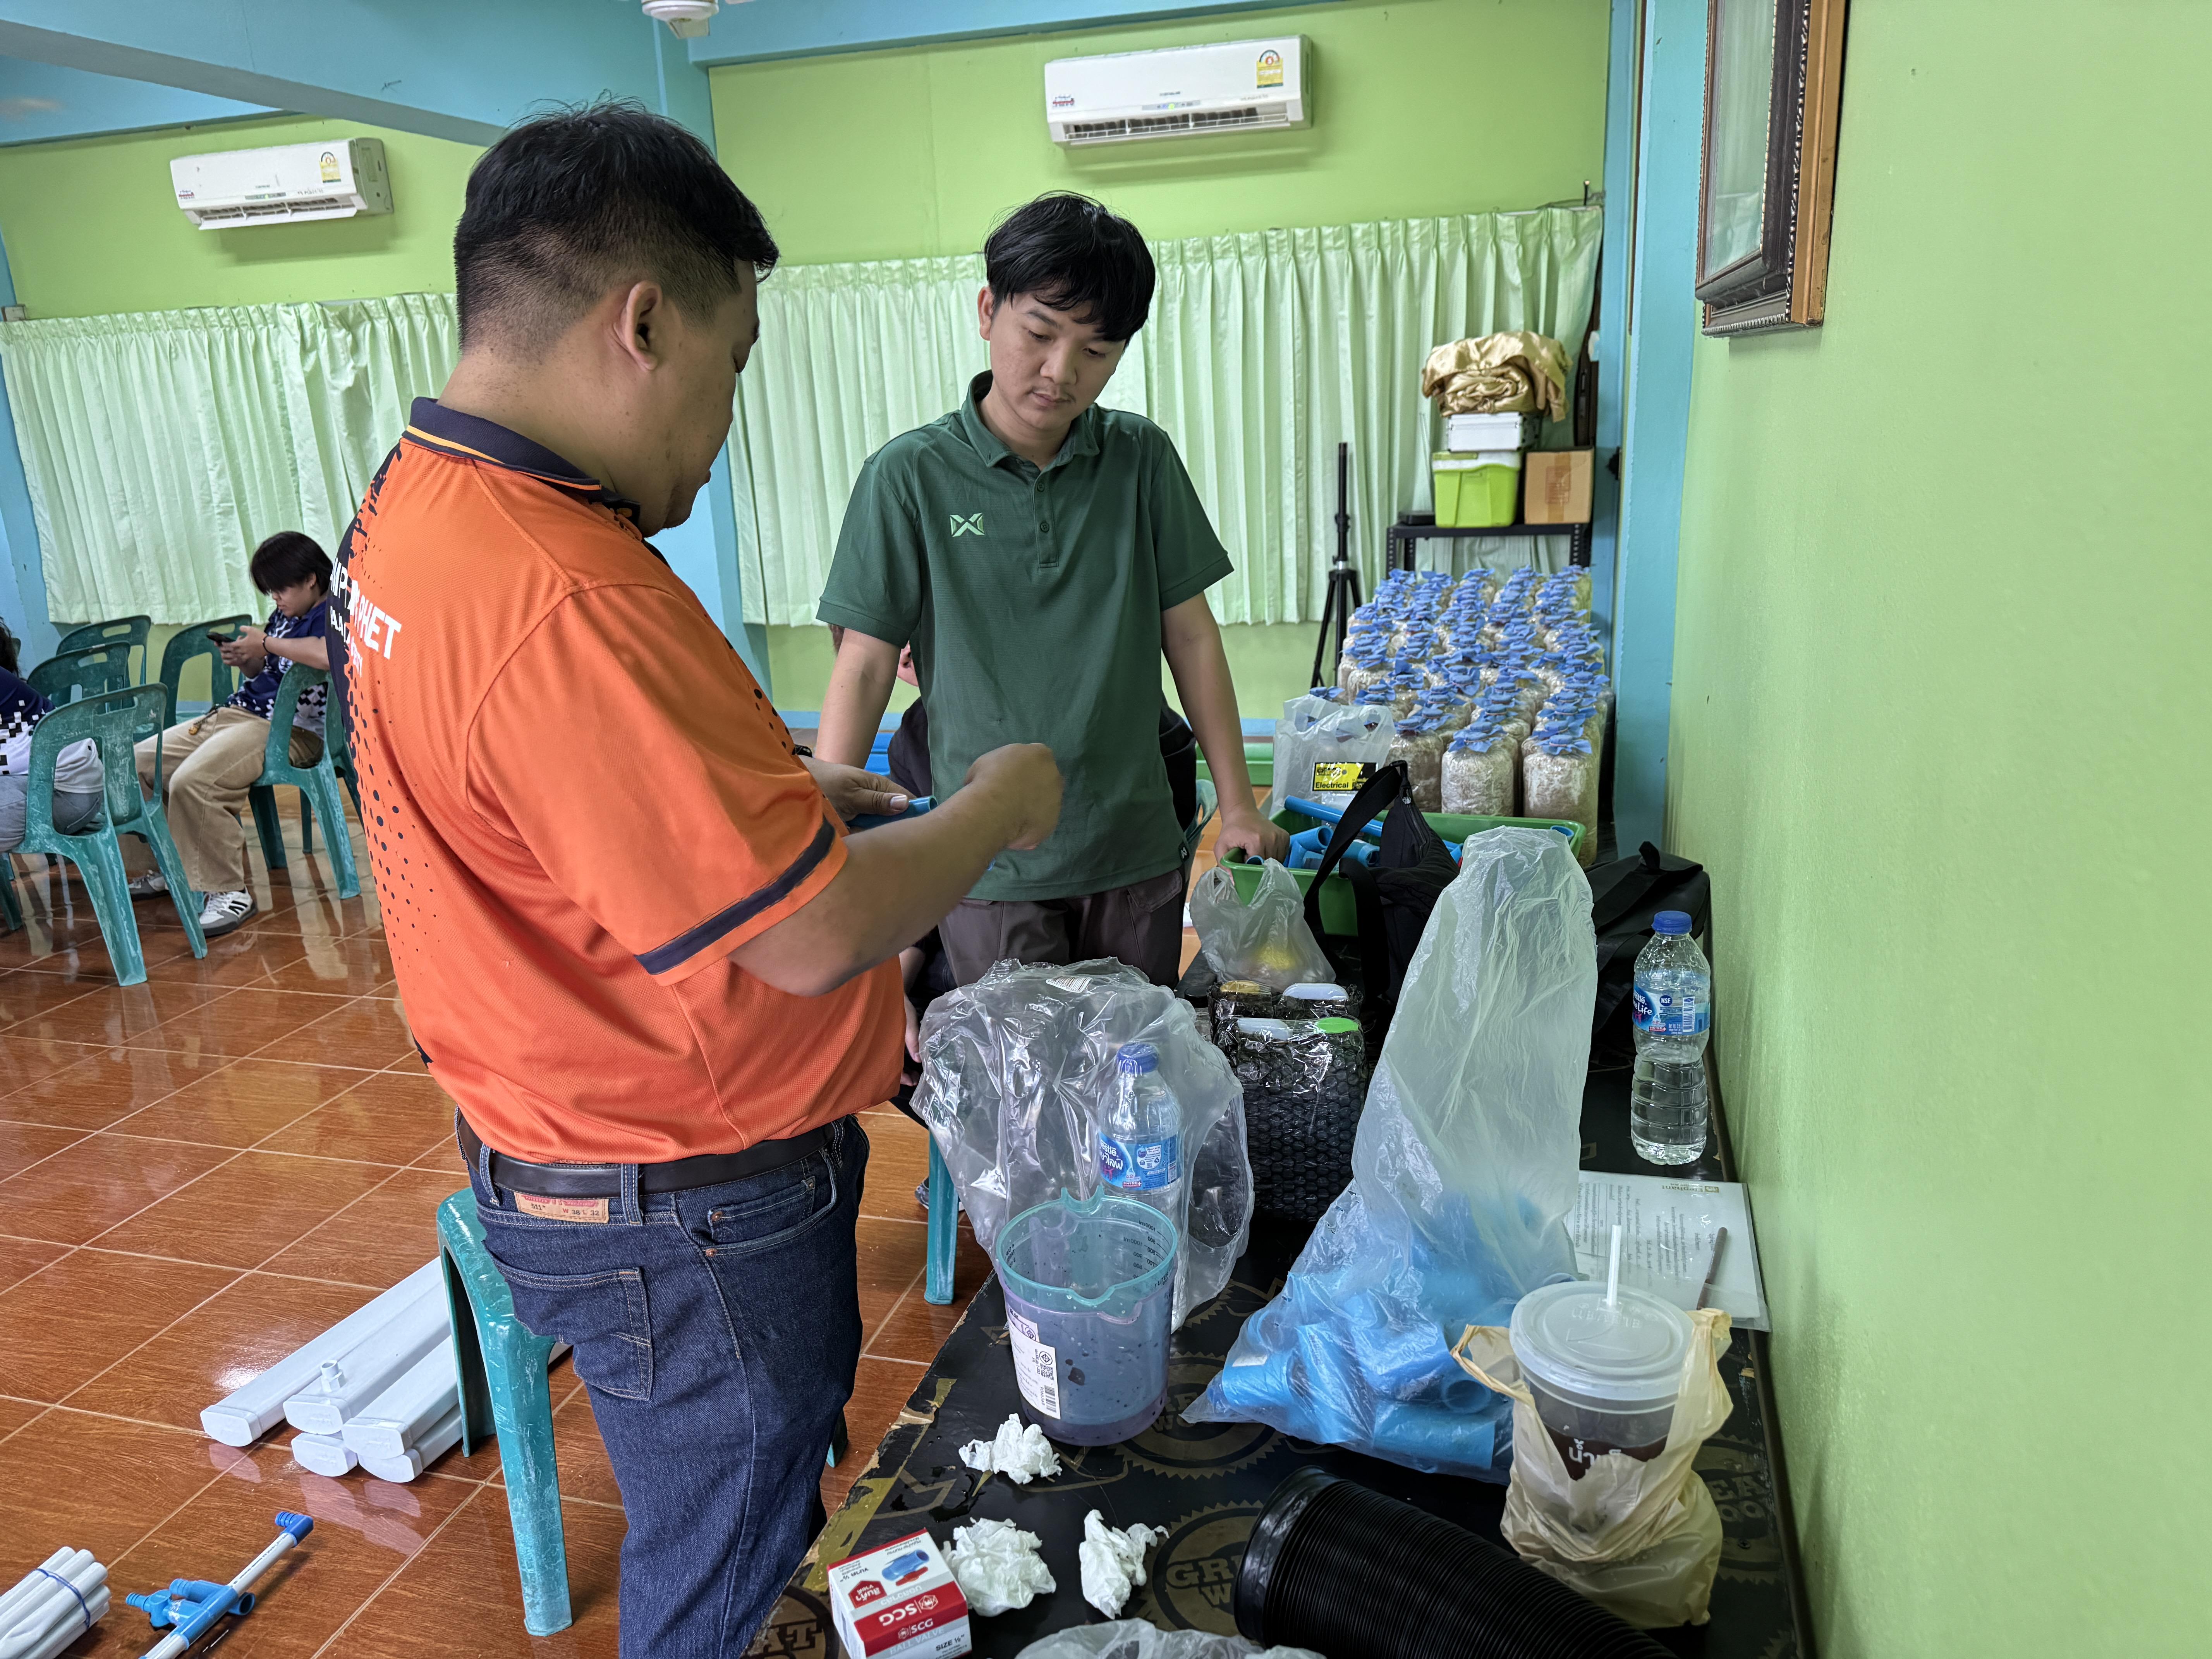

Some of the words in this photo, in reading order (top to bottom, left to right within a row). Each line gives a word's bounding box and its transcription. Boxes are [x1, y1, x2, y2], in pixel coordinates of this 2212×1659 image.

[878, 1602, 917, 1626] SCG
[911, 1618, 934, 1634] SCG
[890, 1640, 913, 1655] BALL
[915, 1628, 944, 1644] VALVE
[936, 1639, 952, 1651] SIZE
